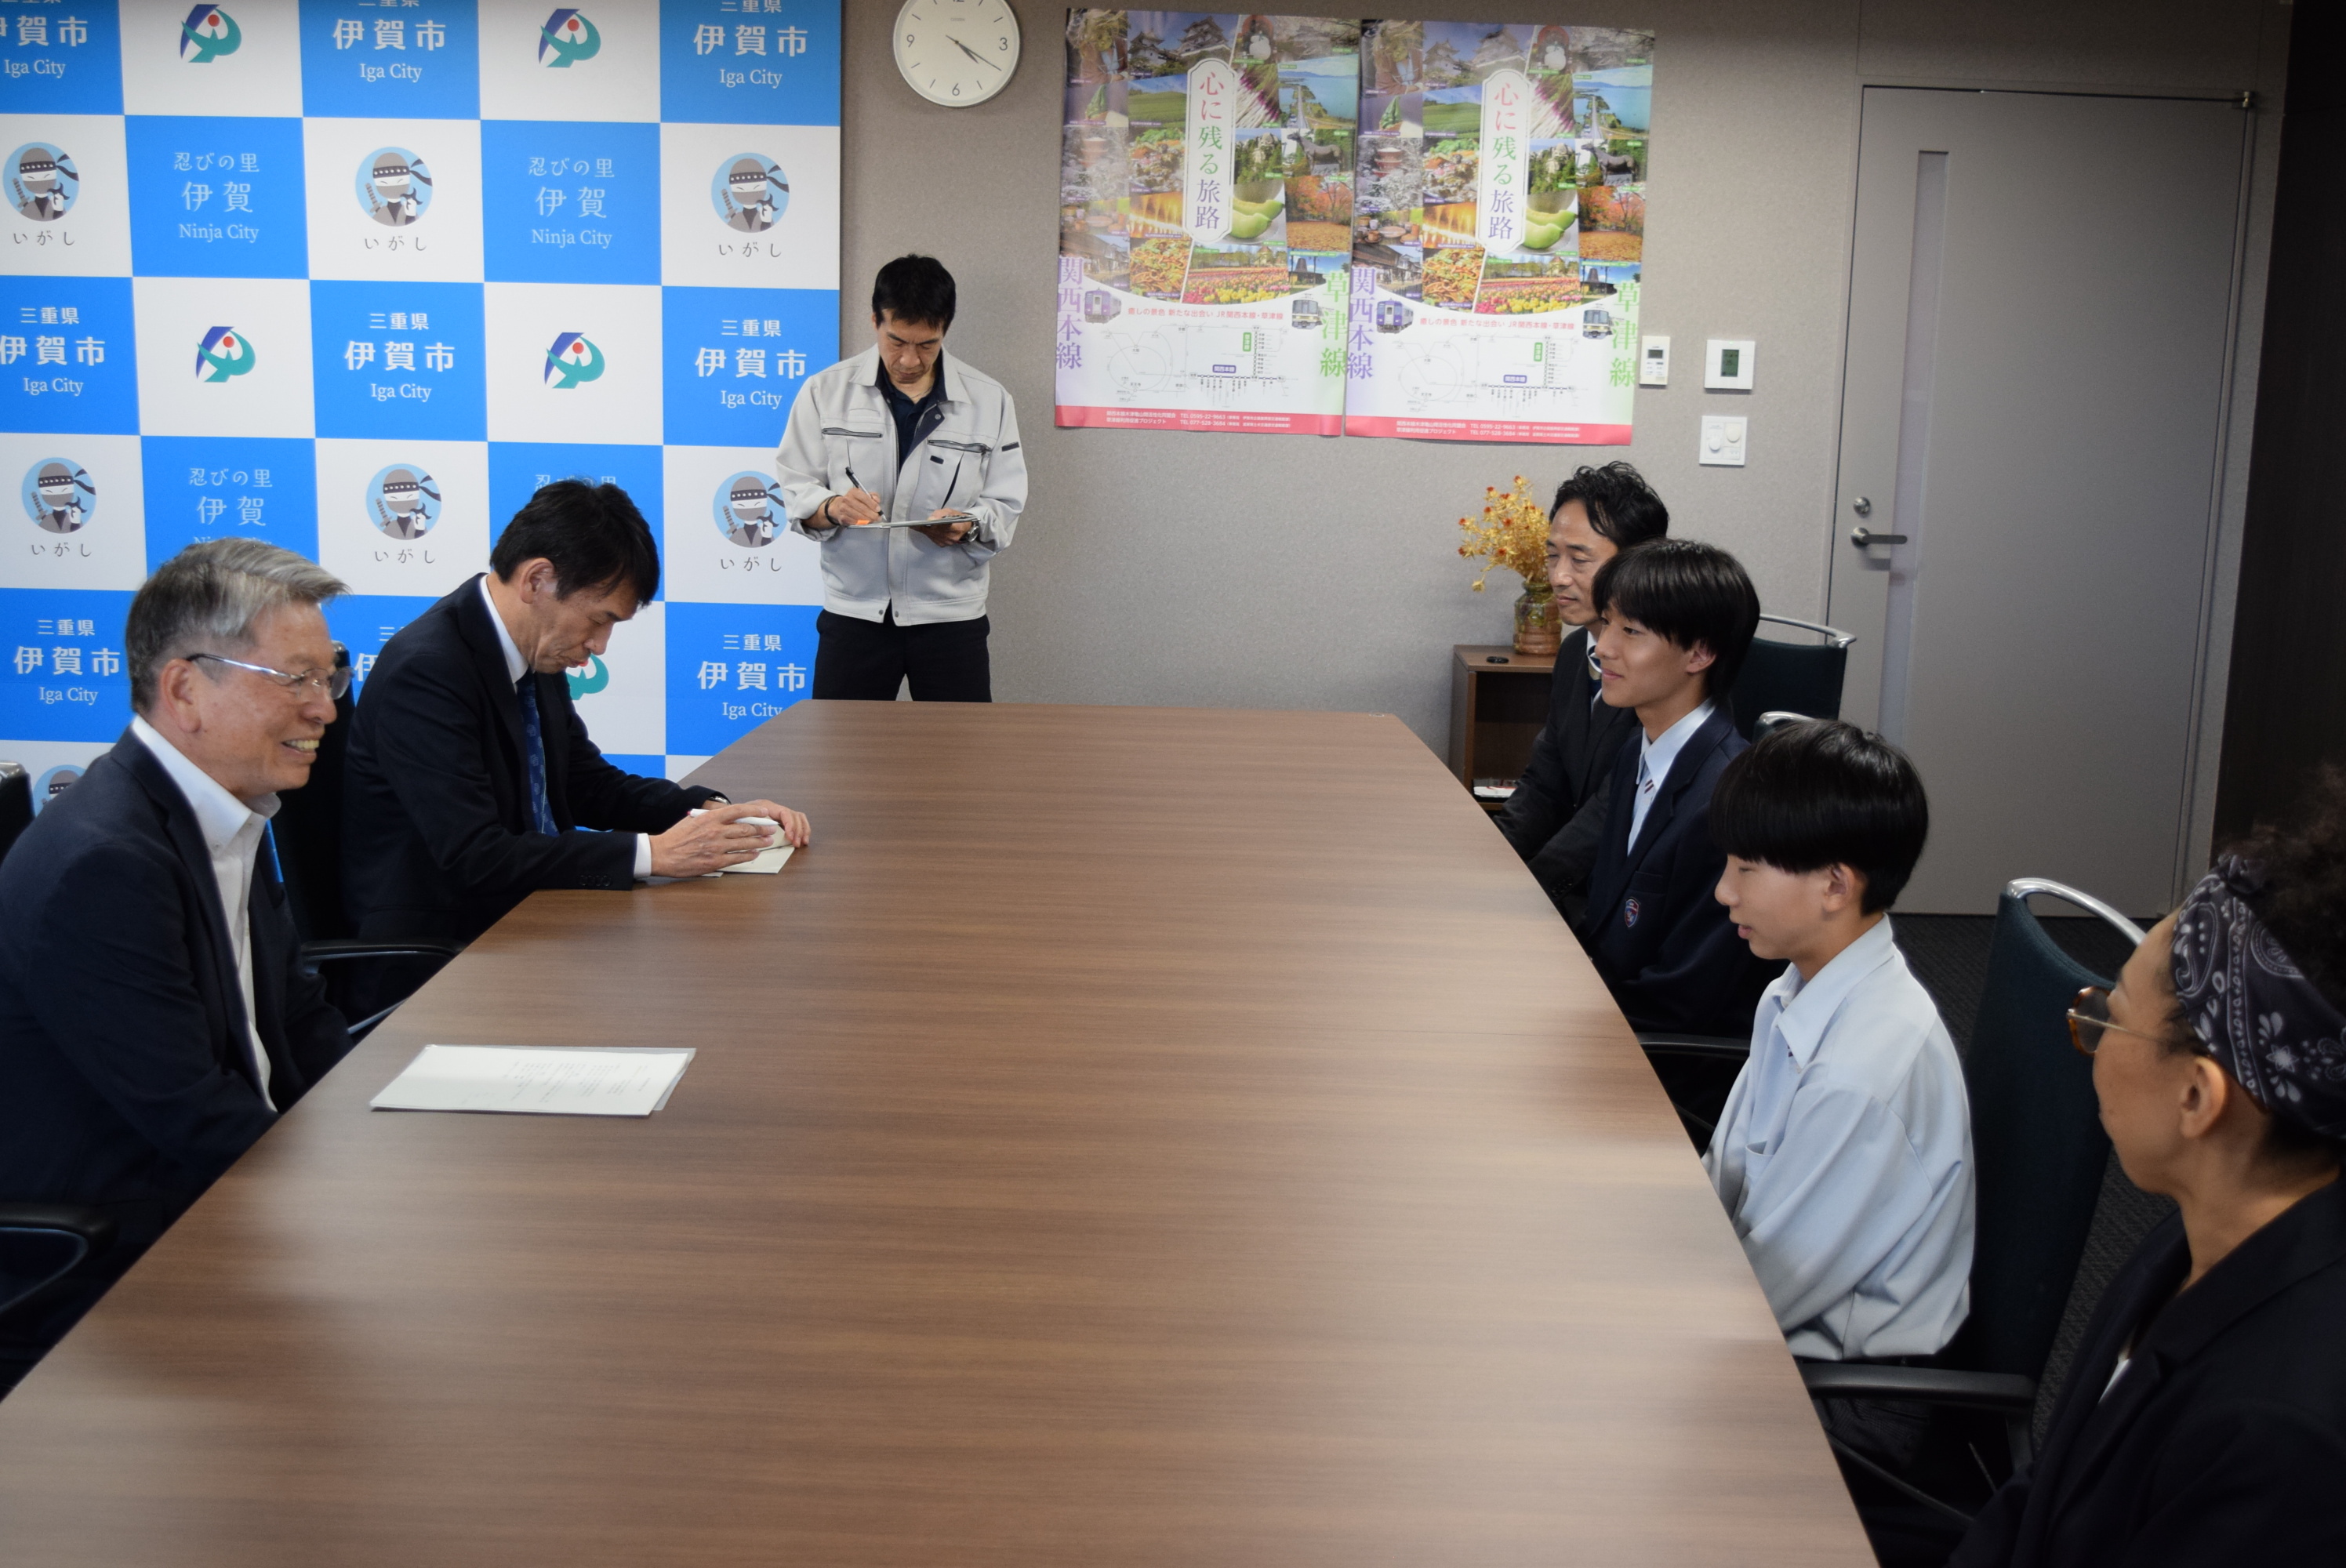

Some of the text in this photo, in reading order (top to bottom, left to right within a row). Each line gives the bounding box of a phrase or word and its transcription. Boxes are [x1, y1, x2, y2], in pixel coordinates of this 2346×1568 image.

[0, 16, 88, 46] 賀市
[332, 20, 446, 50] 伊賀市
[693, 24, 808, 56] 伊賀市
[906, 34, 915, 48] 9
[999, 38, 1008, 51] 3
[4, 60, 66, 78] Iga City
[359, 64, 423, 82] Iga City
[719, 69, 783, 89] Iga City
[952, 83, 961, 96] 6
[1195, 71, 1225, 229] 心に残る旅路
[174, 153, 260, 172] 忍びの里
[528, 158, 615, 177] 忍びの里
[1488, 83, 1519, 239] 心に残る旅路
[181, 182, 253, 212] 伊賀
[536, 187, 607, 218] 伊賀
[13, 231, 74, 245] いがし
[179, 223, 260, 243] Ninja City
[532, 229, 612, 249] Ninja City
[364, 236, 427, 251] いがし
[718, 243, 782, 257] いがし
[20, 307, 80, 324] 三重県
[369, 313, 430, 330] 三重県
[1056, 257, 1084, 369] 関西本線
[1168, 309, 1213, 318] 新たな出会い
[721, 320, 782, 336] 三重県
[1320, 272, 1349, 377] 草津線
[1347, 268, 1375, 379] 関西本線
[1461, 318, 1505, 328] 新たな出会い
[1610, 282, 1641, 387] 草津線
[0, 336, 105, 365] 伊賀市
[344, 341, 455, 372] 伊賀市
[695, 347, 807, 379] 伊賀市
[23, 378, 84, 396] Iga City
[370, 383, 432, 402] Iga City
[721, 390, 783, 409] Iga City
[189, 468, 273, 487] 忍びの里
[196, 496, 267, 526] 伊賀
[31, 543, 91, 557] いがし
[374, 549, 435, 564] いがし
[720, 557, 782, 572] いがし
[38, 619, 96, 636] 三重県
[723, 634, 782, 651] 三重県
[13, 646, 121, 676] 伊賀市
[696, 661, 807, 691] 伊賀市
[39, 687, 99, 705] Iga City
[722, 702, 747, 720] Iga
